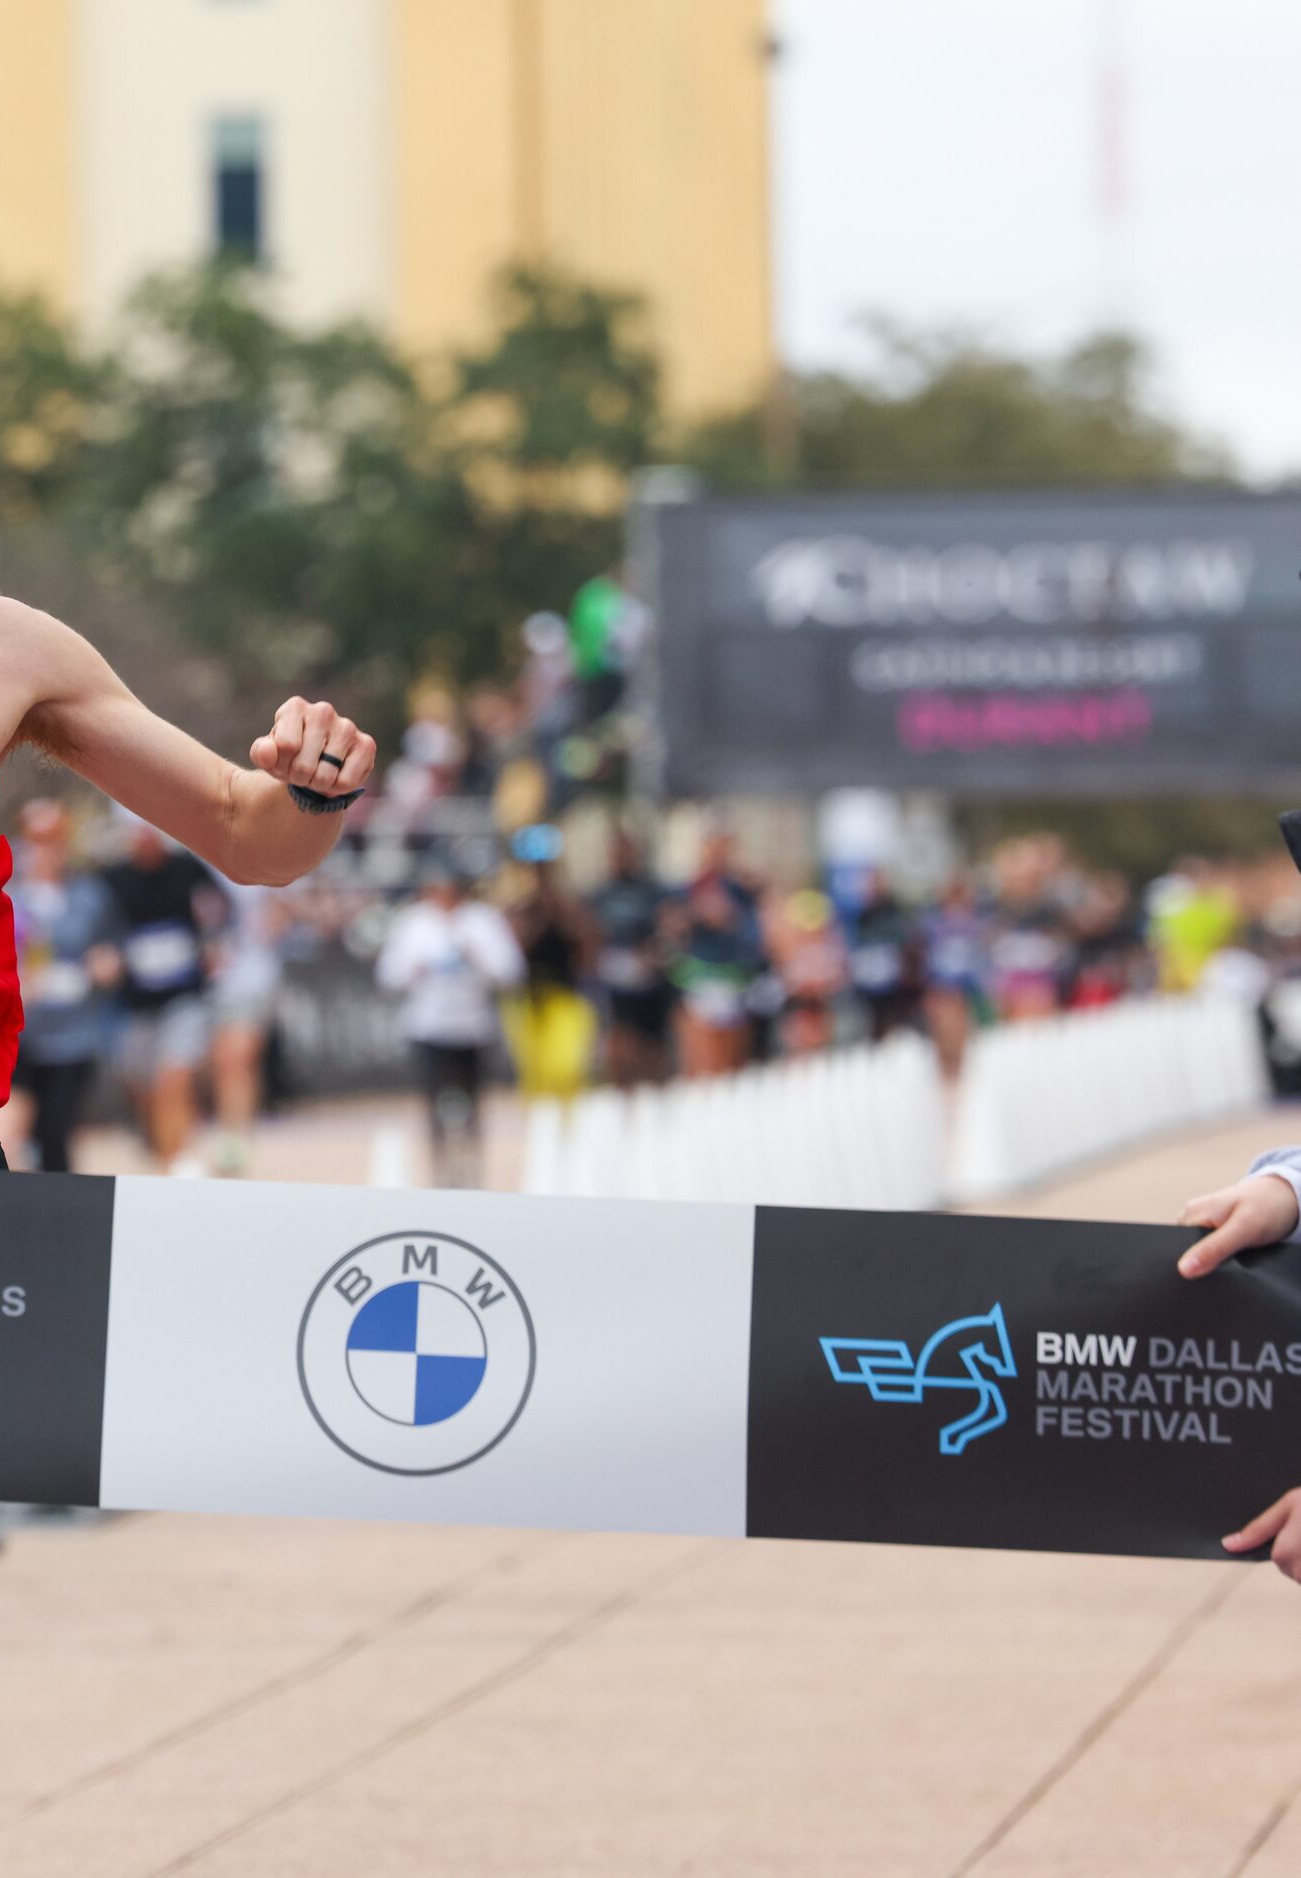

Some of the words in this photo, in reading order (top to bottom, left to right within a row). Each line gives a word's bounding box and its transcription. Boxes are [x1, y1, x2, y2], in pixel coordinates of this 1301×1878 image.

[333, 1244, 506, 1310] BMW
[1036, 1331, 1138, 1368] BMW
[1148, 1336, 1301, 1375] DALLAS
[1036, 1369, 1274, 1411] MARATHON
[1035, 1405, 1233, 1444] FESTIVAL
